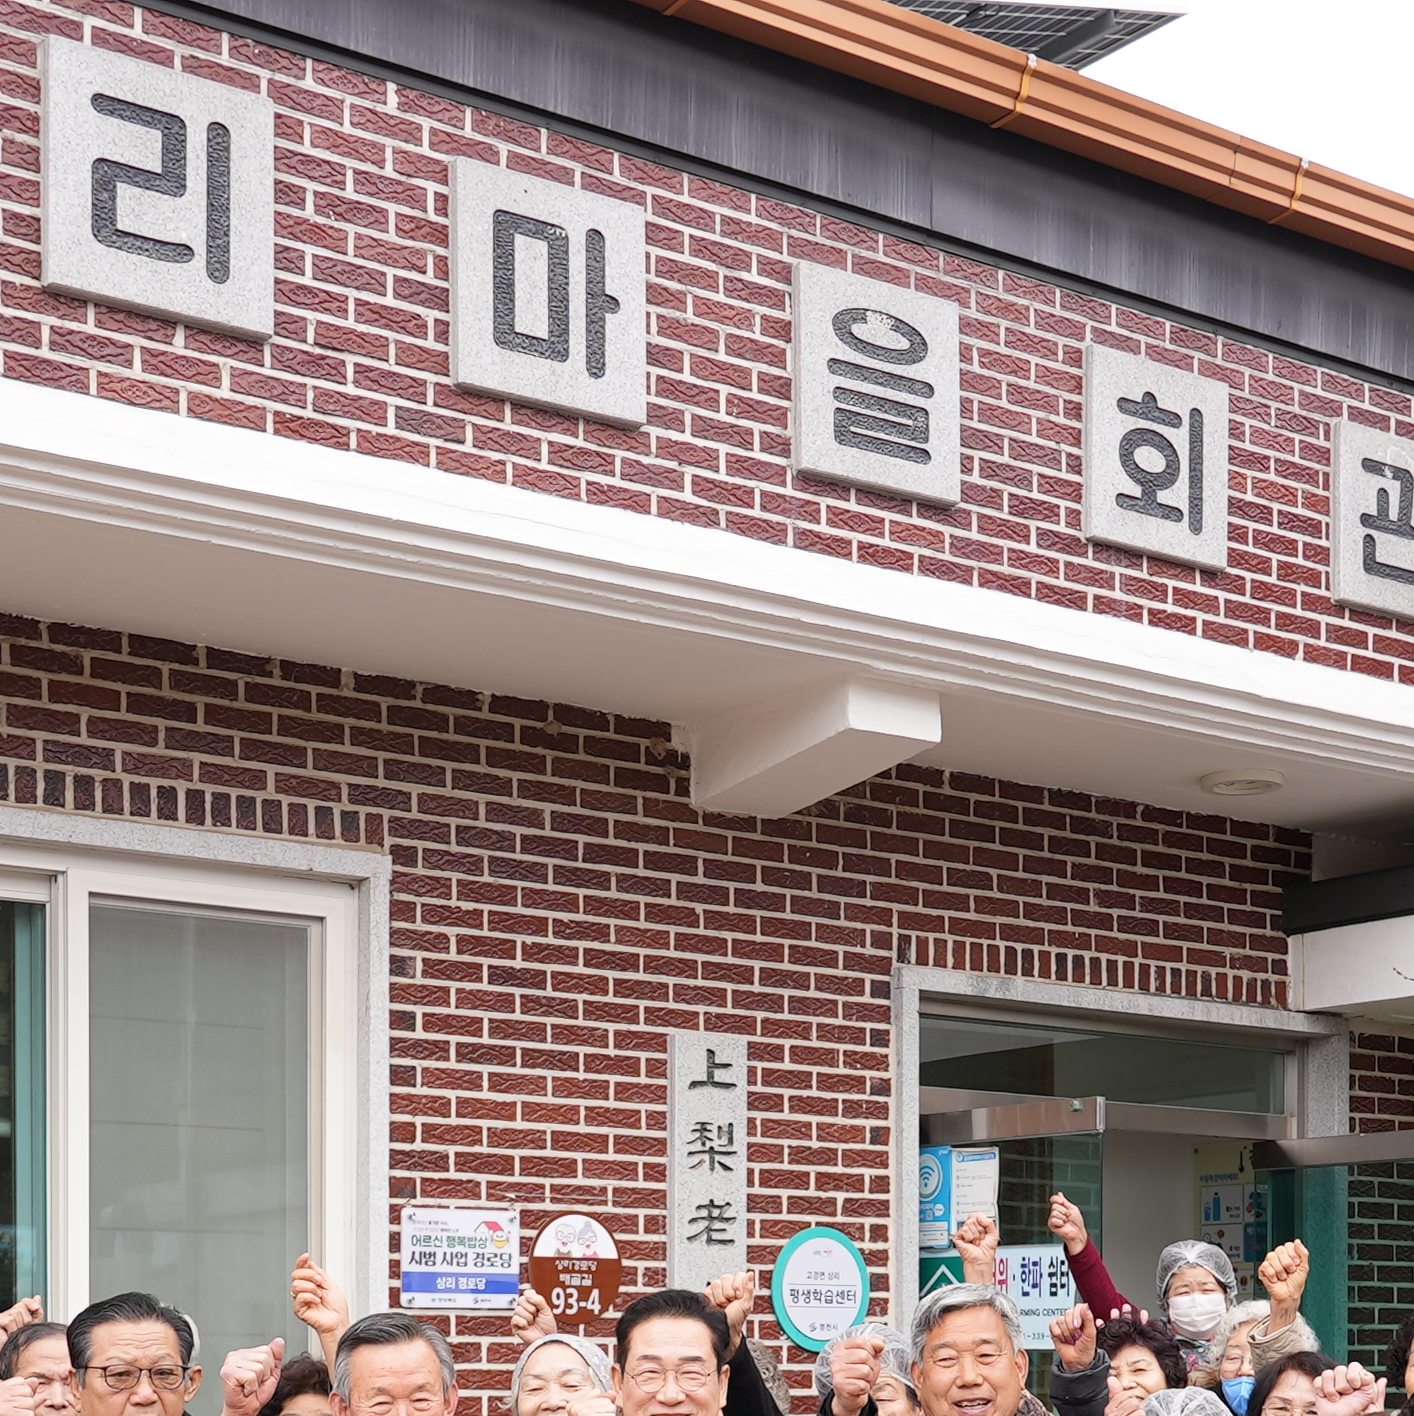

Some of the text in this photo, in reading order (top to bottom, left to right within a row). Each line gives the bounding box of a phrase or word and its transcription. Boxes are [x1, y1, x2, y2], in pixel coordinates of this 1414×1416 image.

[686, 1048, 737, 1288] 上梨老
[411, 1234, 488, 1249] 어르신 행복밥상
[408, 1250, 513, 1268] 시범 사업 경로당
[436, 1276, 486, 1290] 상리 경로당
[1048, 1256, 1070, 1298] 쉼터
[551, 1287, 602, 1316] 93-4
[789, 1288, 857, 1305] 평생학습센터
